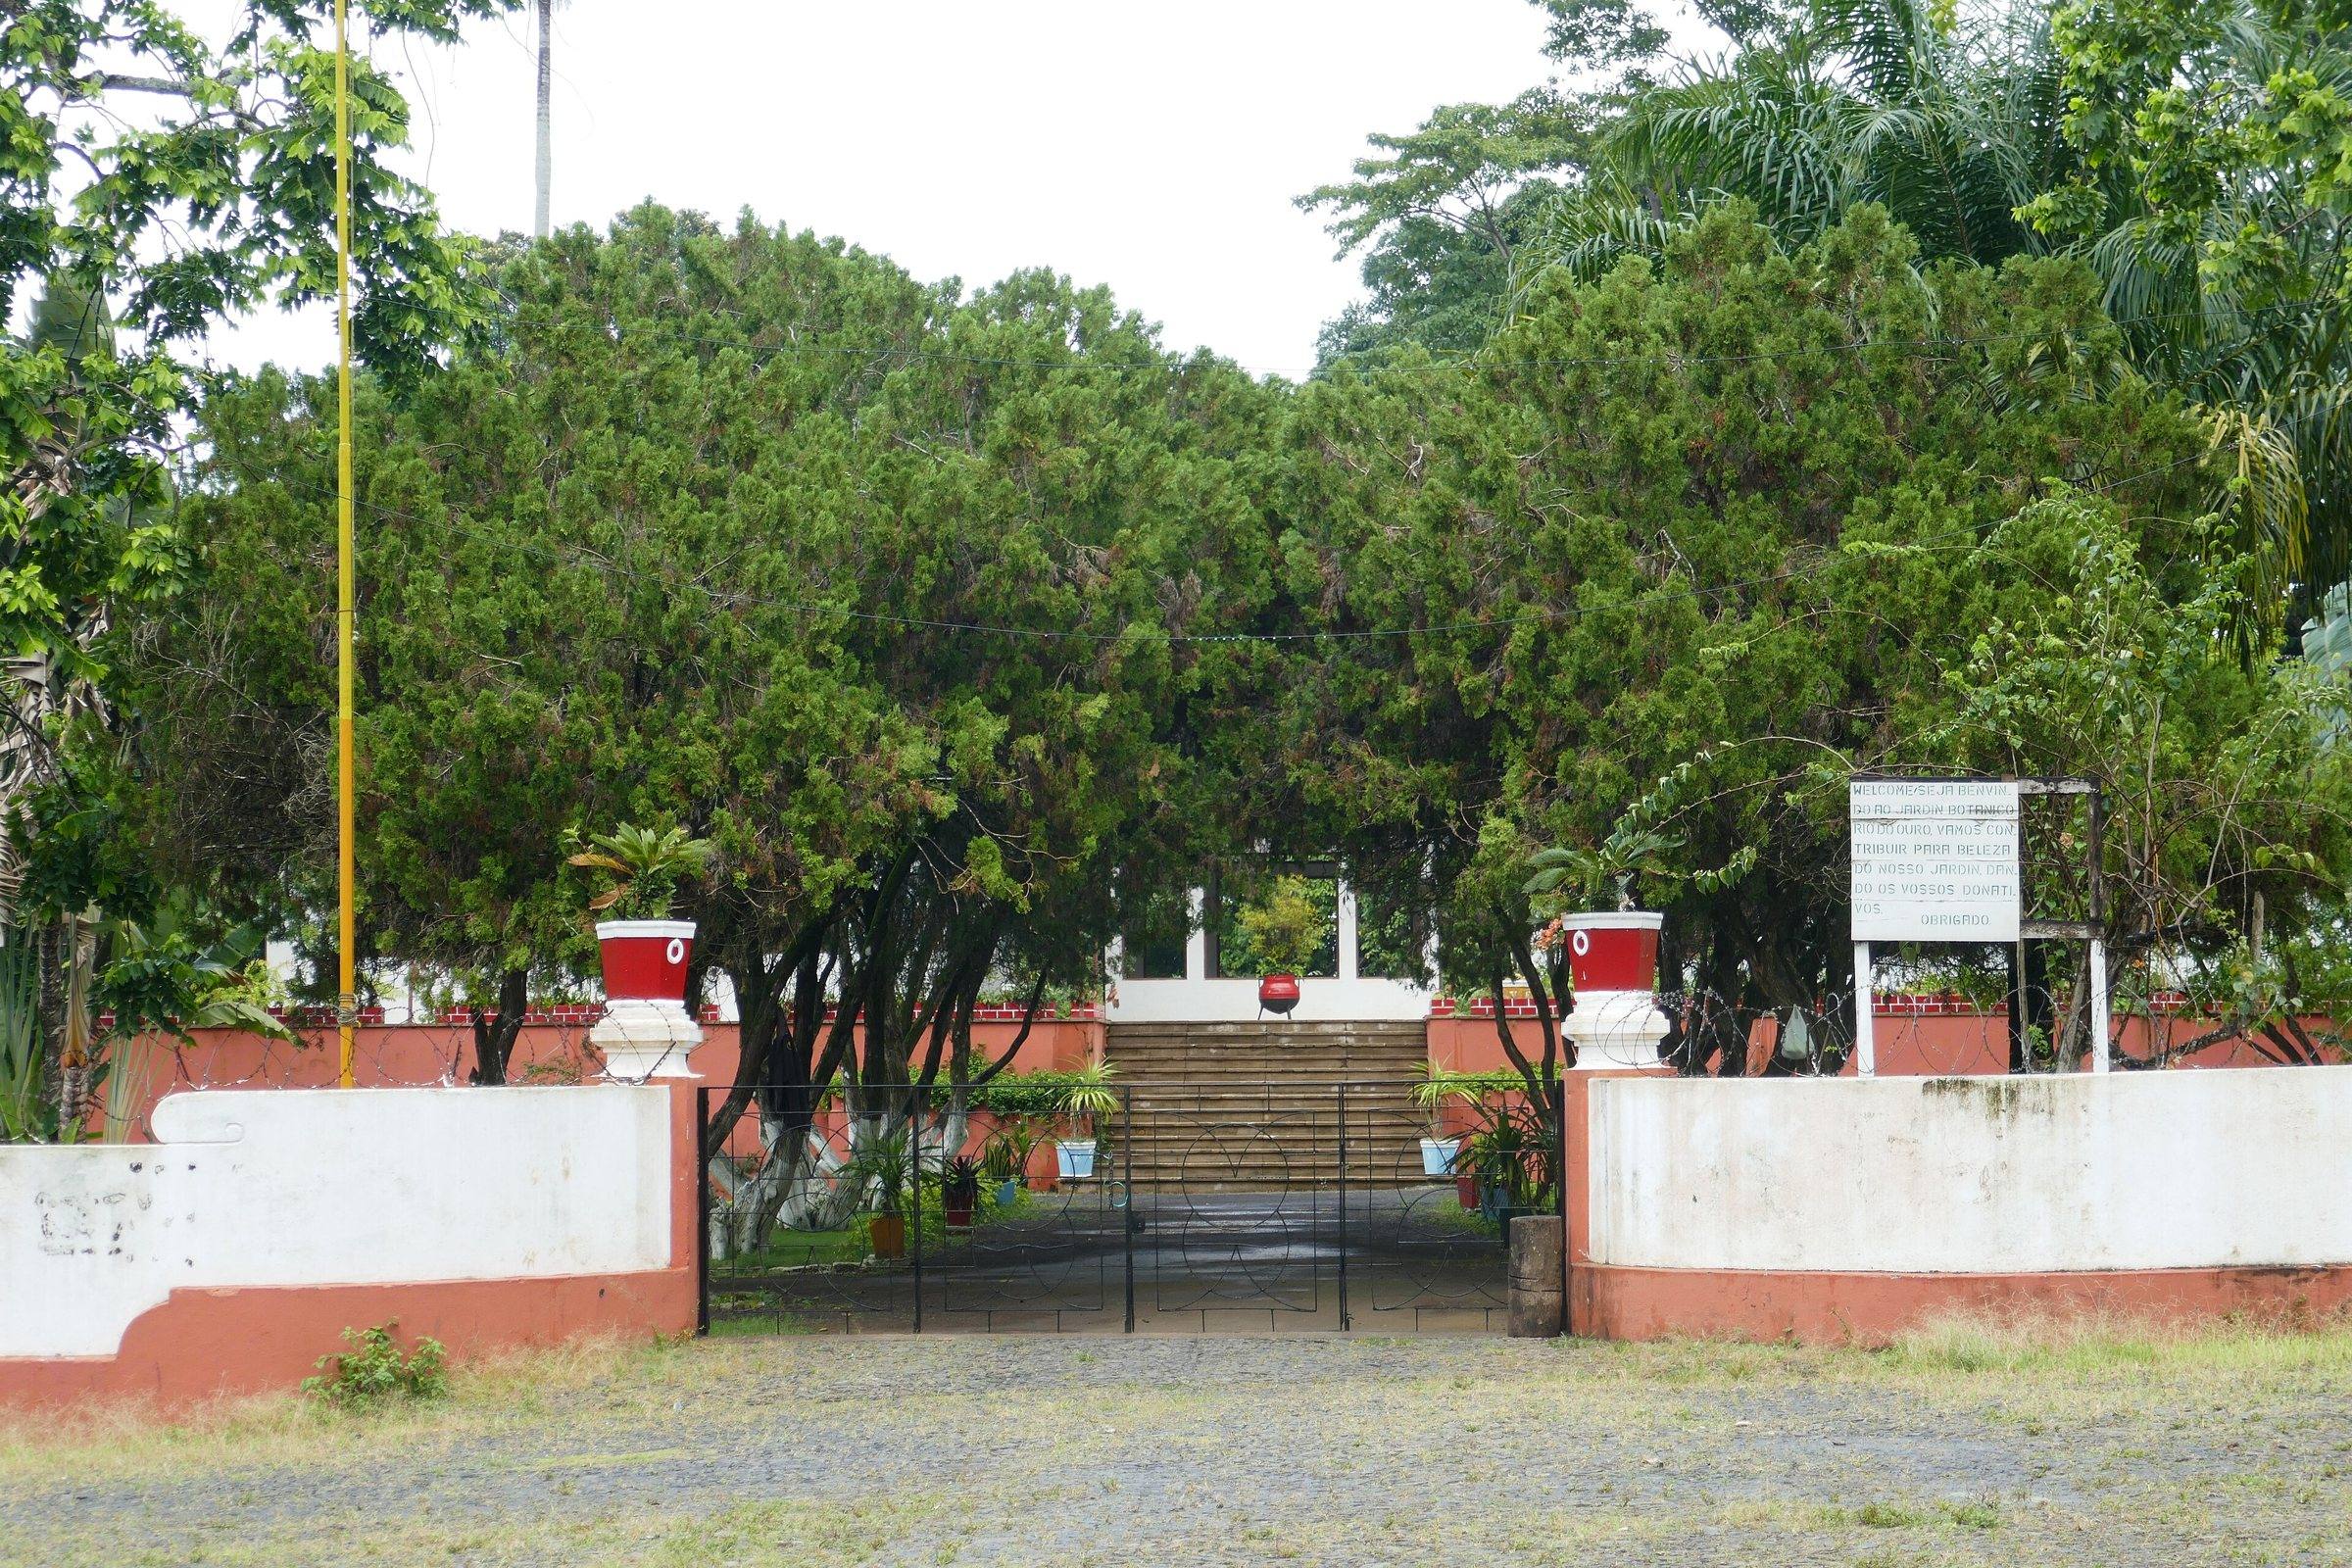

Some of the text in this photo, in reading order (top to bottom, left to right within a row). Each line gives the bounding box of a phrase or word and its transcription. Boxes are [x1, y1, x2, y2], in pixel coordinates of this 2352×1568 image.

[1854, 805, 2014, 815] DO AO JARDIN BOTANICO
[1855, 824, 1874, 834] RIO
[1878, 824, 1893, 834] DO
[1936, 824, 1982, 836] VAMOS
[1854, 844, 2011, 856] TRIBUIR PARA BELEZA
[1855, 863, 1872, 874] DO
[1879, 863, 1924, 874] NOSSO
[1855, 883, 1872, 894] DO
[1879, 883, 1895, 894] OS
[1901, 884, 1954, 895] VOSSOS
